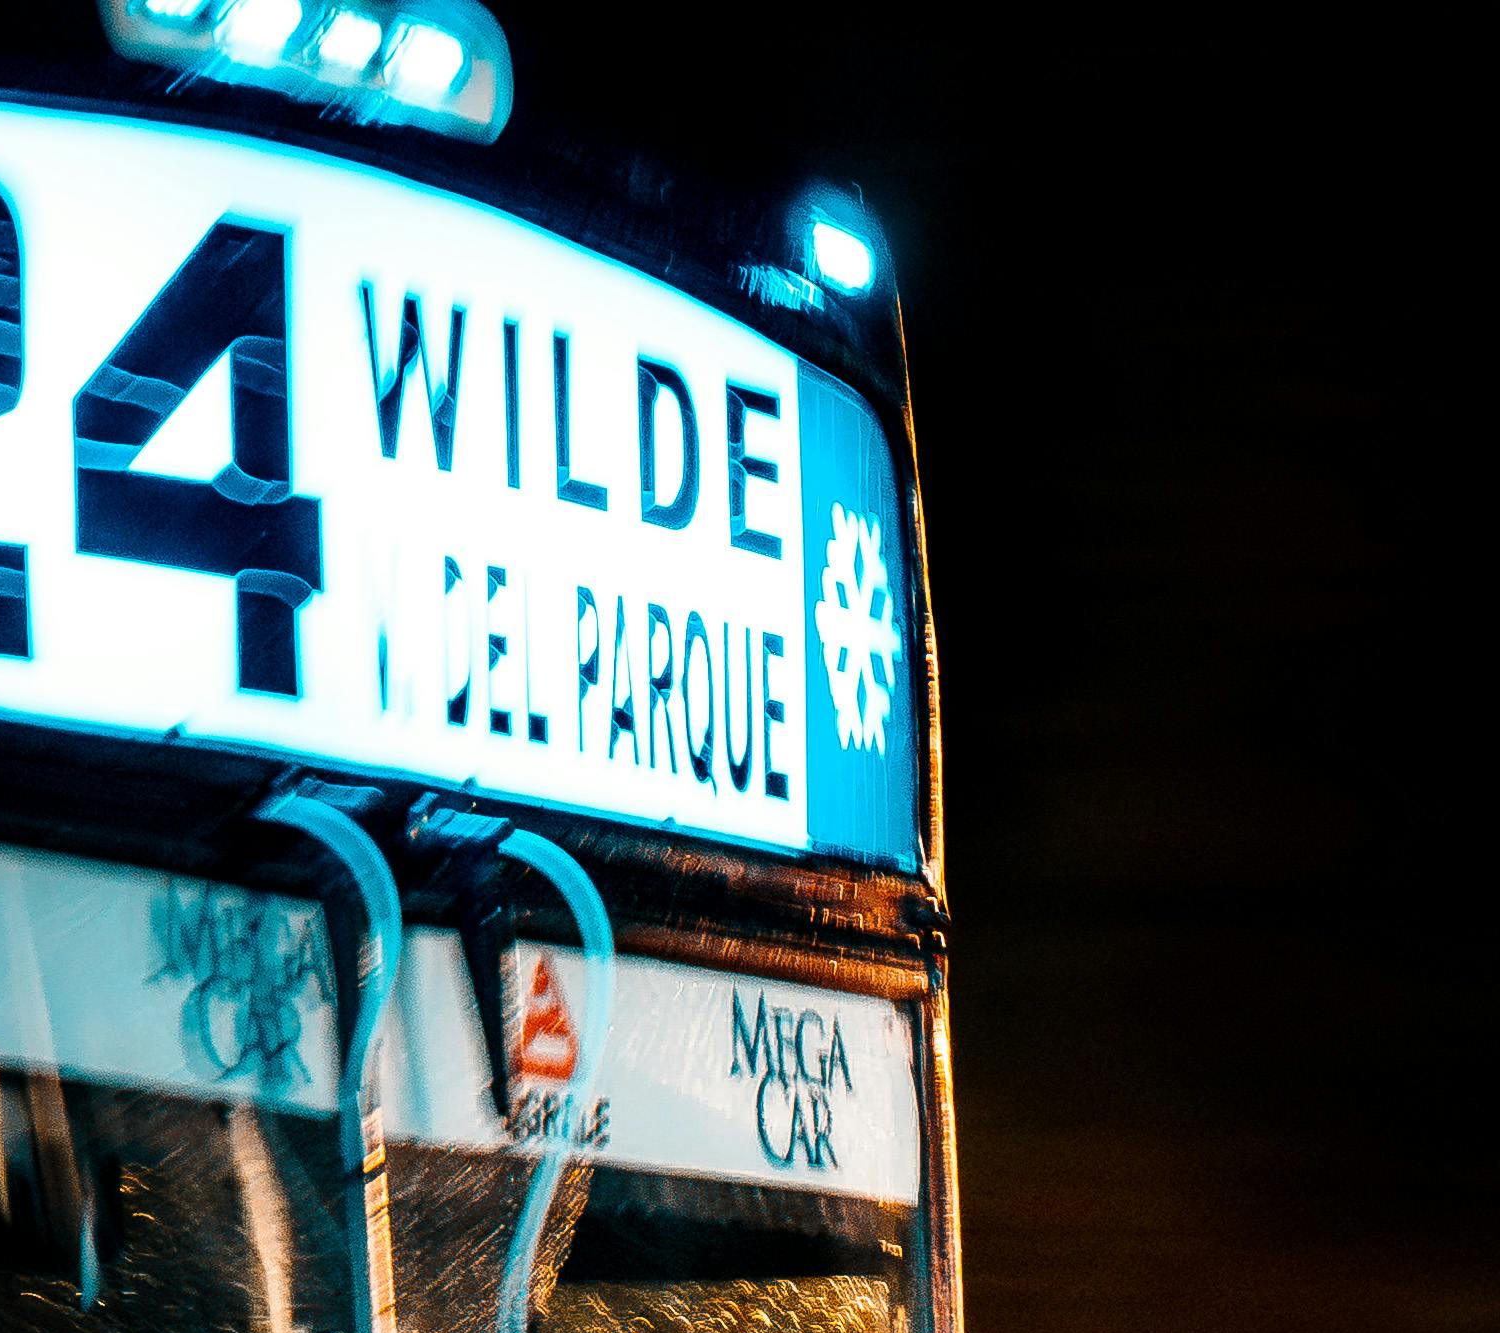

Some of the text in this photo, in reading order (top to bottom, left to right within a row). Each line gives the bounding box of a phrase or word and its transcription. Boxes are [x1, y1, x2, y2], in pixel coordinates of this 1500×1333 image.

[361, 280, 782, 560] WILDE
[444, 555, 548, 744] DEL
[577, 585, 789, 801] PARQUE
[730, 985, 852, 1094] MEGA
[756, 1070, 839, 1170] CAR
